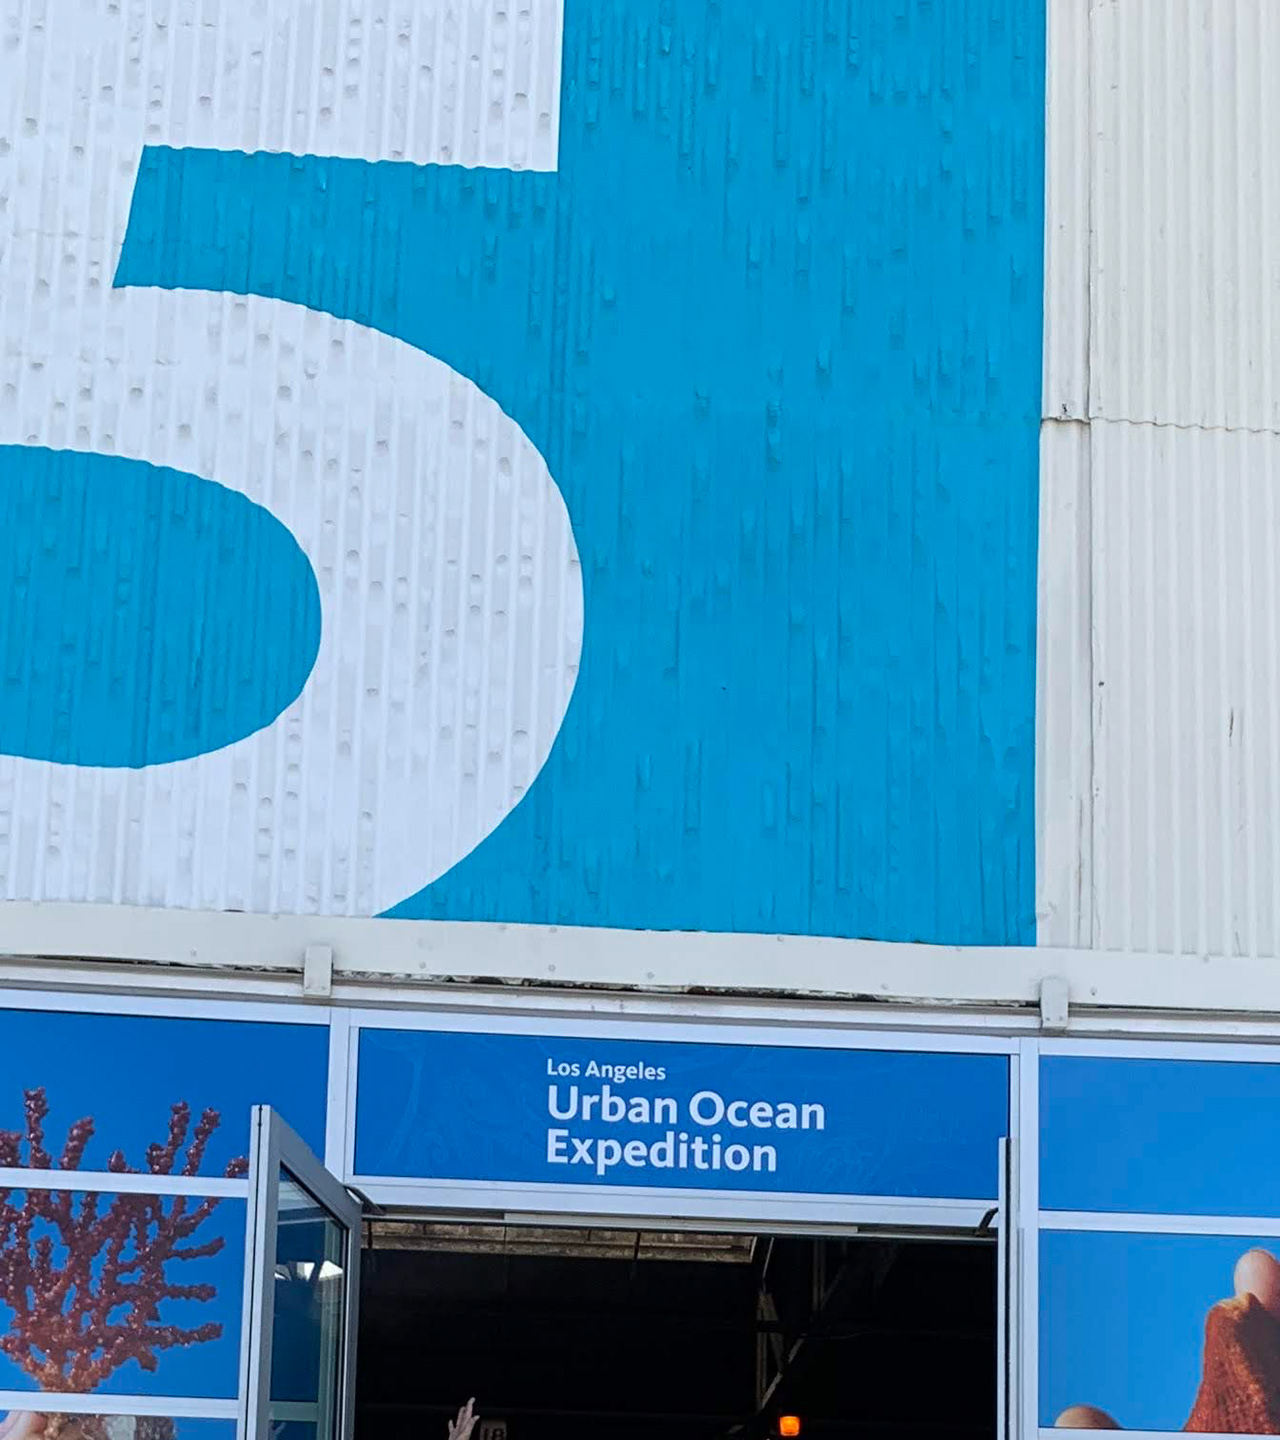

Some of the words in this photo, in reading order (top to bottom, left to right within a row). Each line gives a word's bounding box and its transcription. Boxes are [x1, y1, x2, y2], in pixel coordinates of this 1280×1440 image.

[547, 1058, 580, 1077] Los
[584, 1060, 666, 1083] Angeles
[548, 1084, 678, 1124] Urban
[688, 1090, 825, 1130] Ocean
[547, 1128, 777, 1175] Expedition
